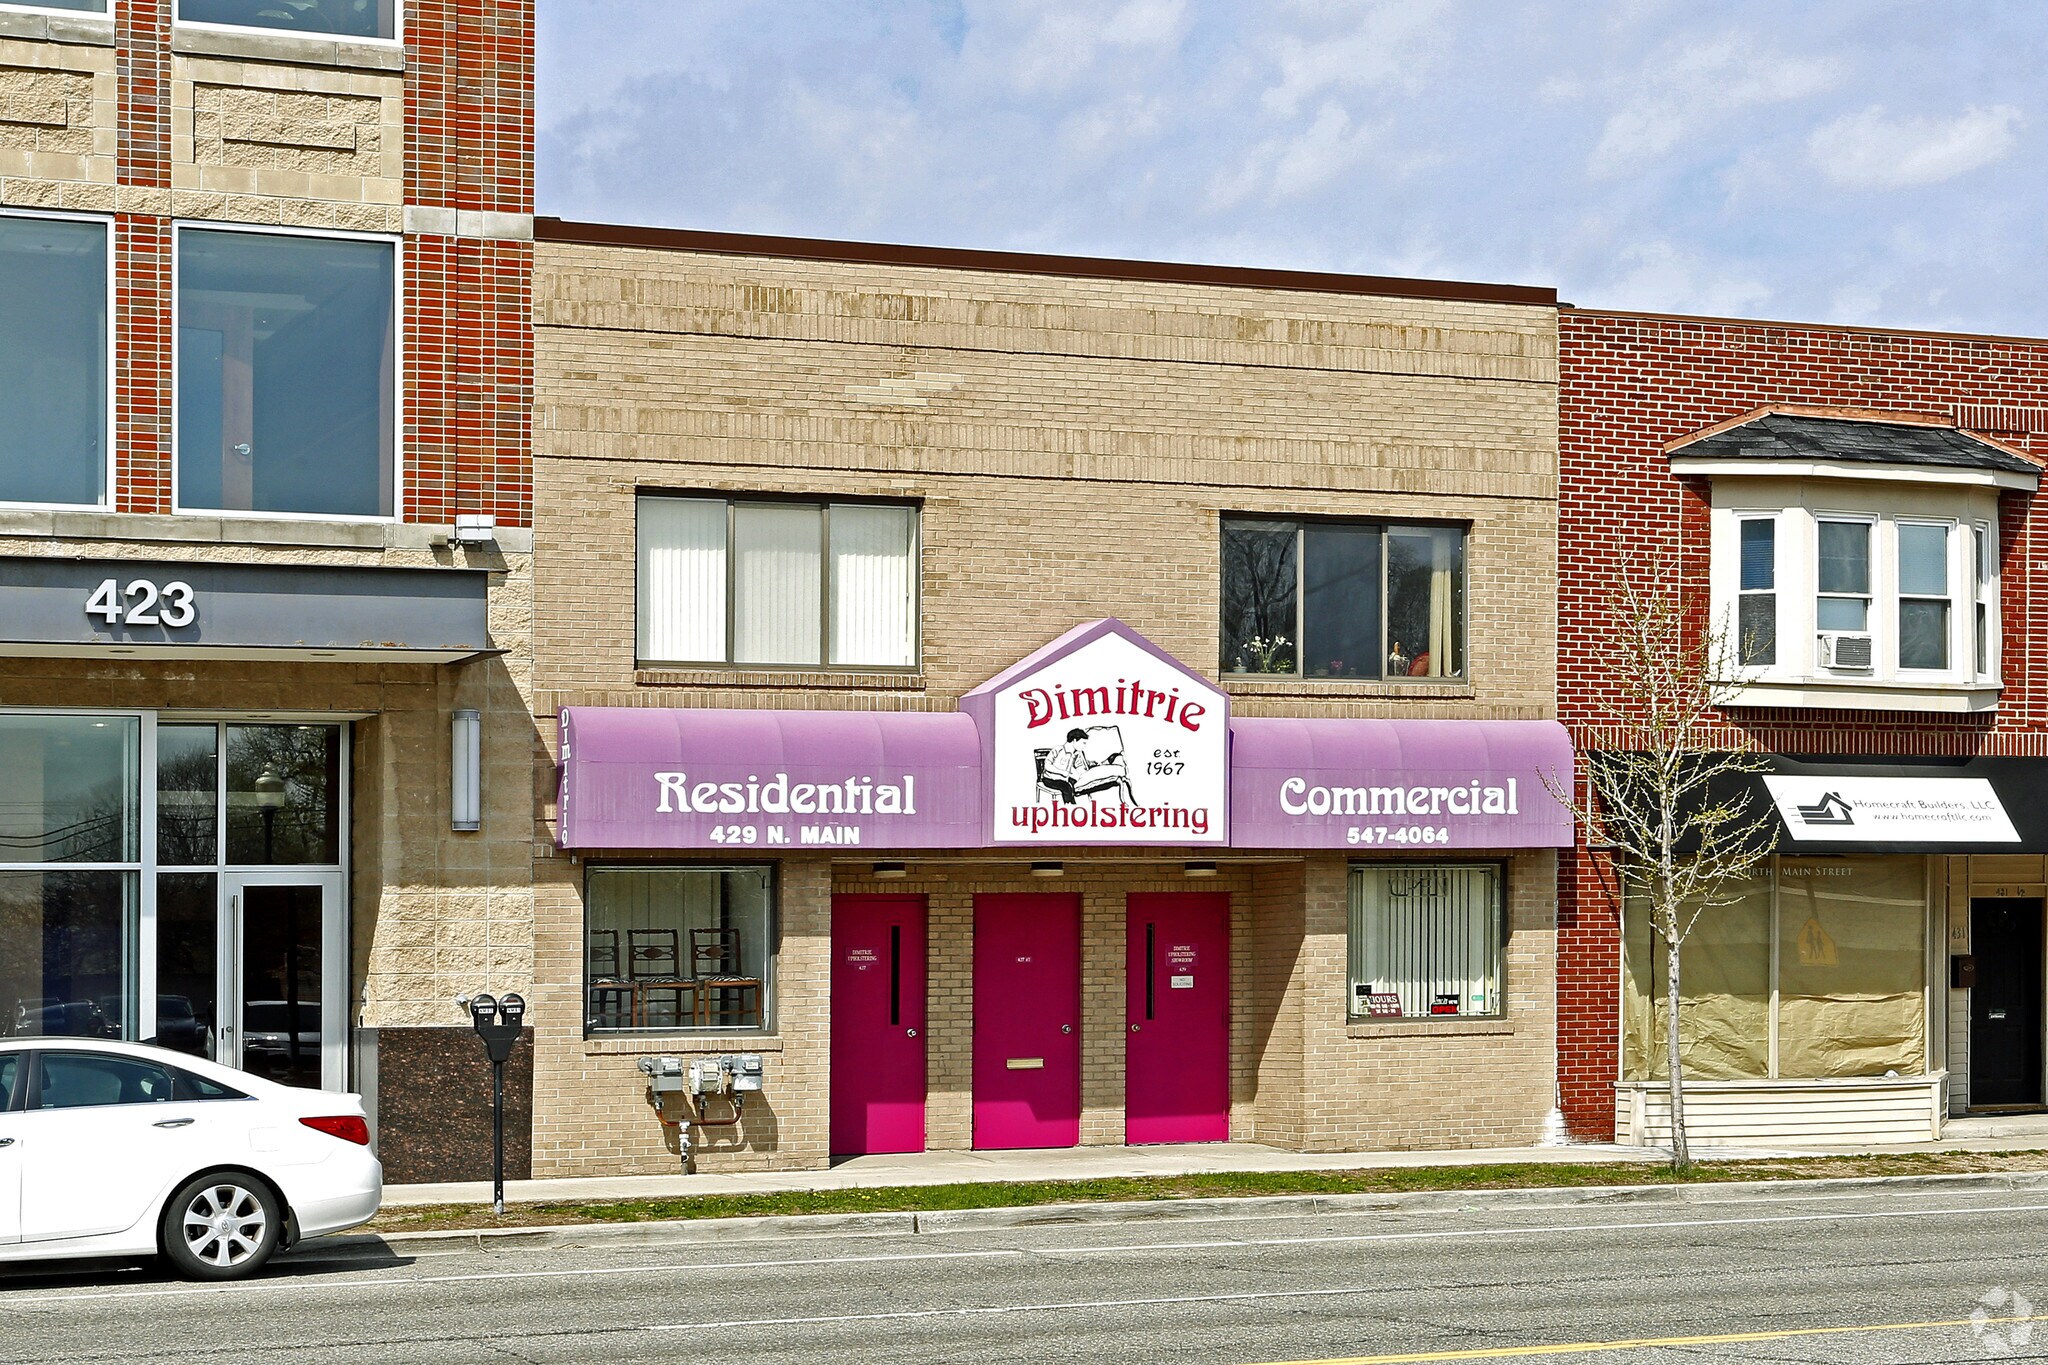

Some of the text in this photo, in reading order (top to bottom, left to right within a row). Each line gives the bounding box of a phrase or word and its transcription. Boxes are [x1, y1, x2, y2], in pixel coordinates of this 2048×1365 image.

[86, 579, 196, 628] 423
[1019, 678, 1206, 733] Dimitrie
[1147, 761, 1185, 776] 1967
[654, 772, 917, 816] Residential
[1280, 777, 1520, 816] Commercial
[1853, 800, 1916, 811] Homecraft
[1971, 801, 1995, 810] LLC
[709, 825, 861, 846] 429 N. MAIN
[1012, 800, 1209, 836] upholstering
[1346, 826, 1449, 845] 547-4064
